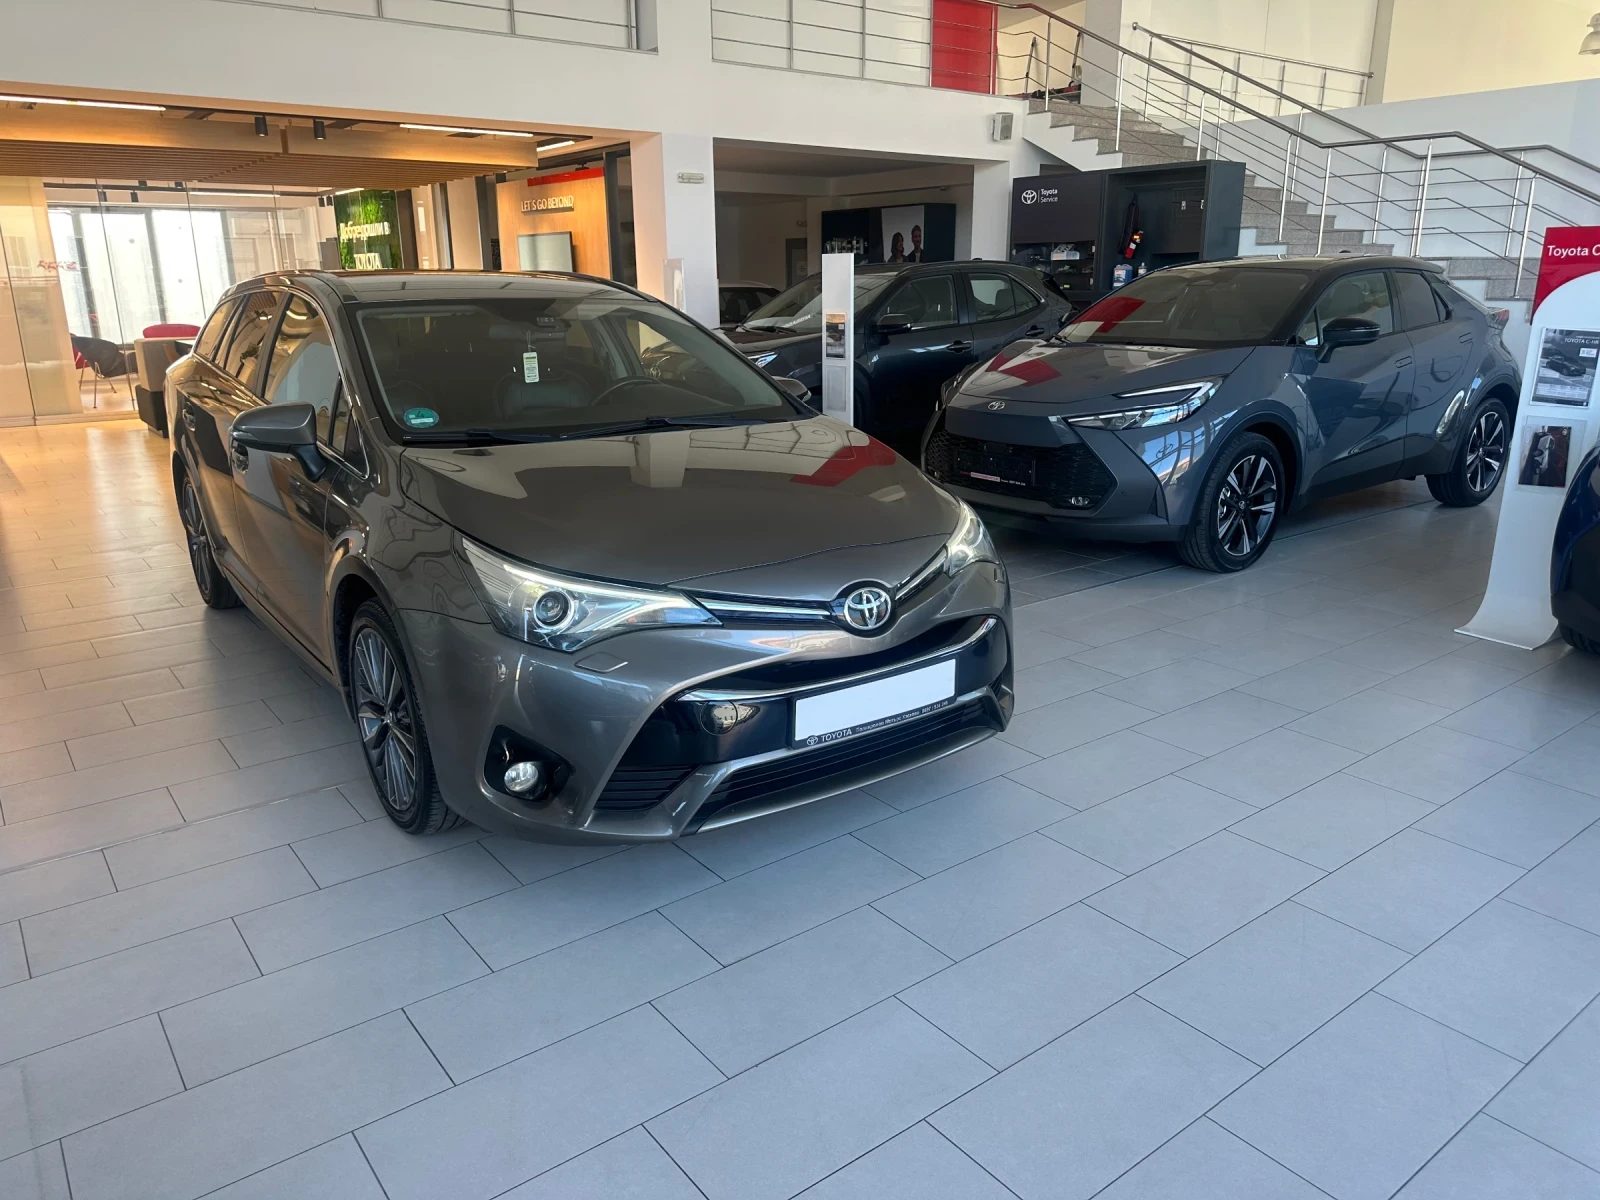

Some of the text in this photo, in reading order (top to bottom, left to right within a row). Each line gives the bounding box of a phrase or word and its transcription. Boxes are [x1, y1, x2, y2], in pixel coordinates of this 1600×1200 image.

[1041, 188, 1058, 196] Toyota
[537, 198, 547, 210] GO
[548, 195, 574, 209] BEYOND
[1547, 245, 1589, 259] Toyota
[821, 728, 852, 742] TOYOTA
